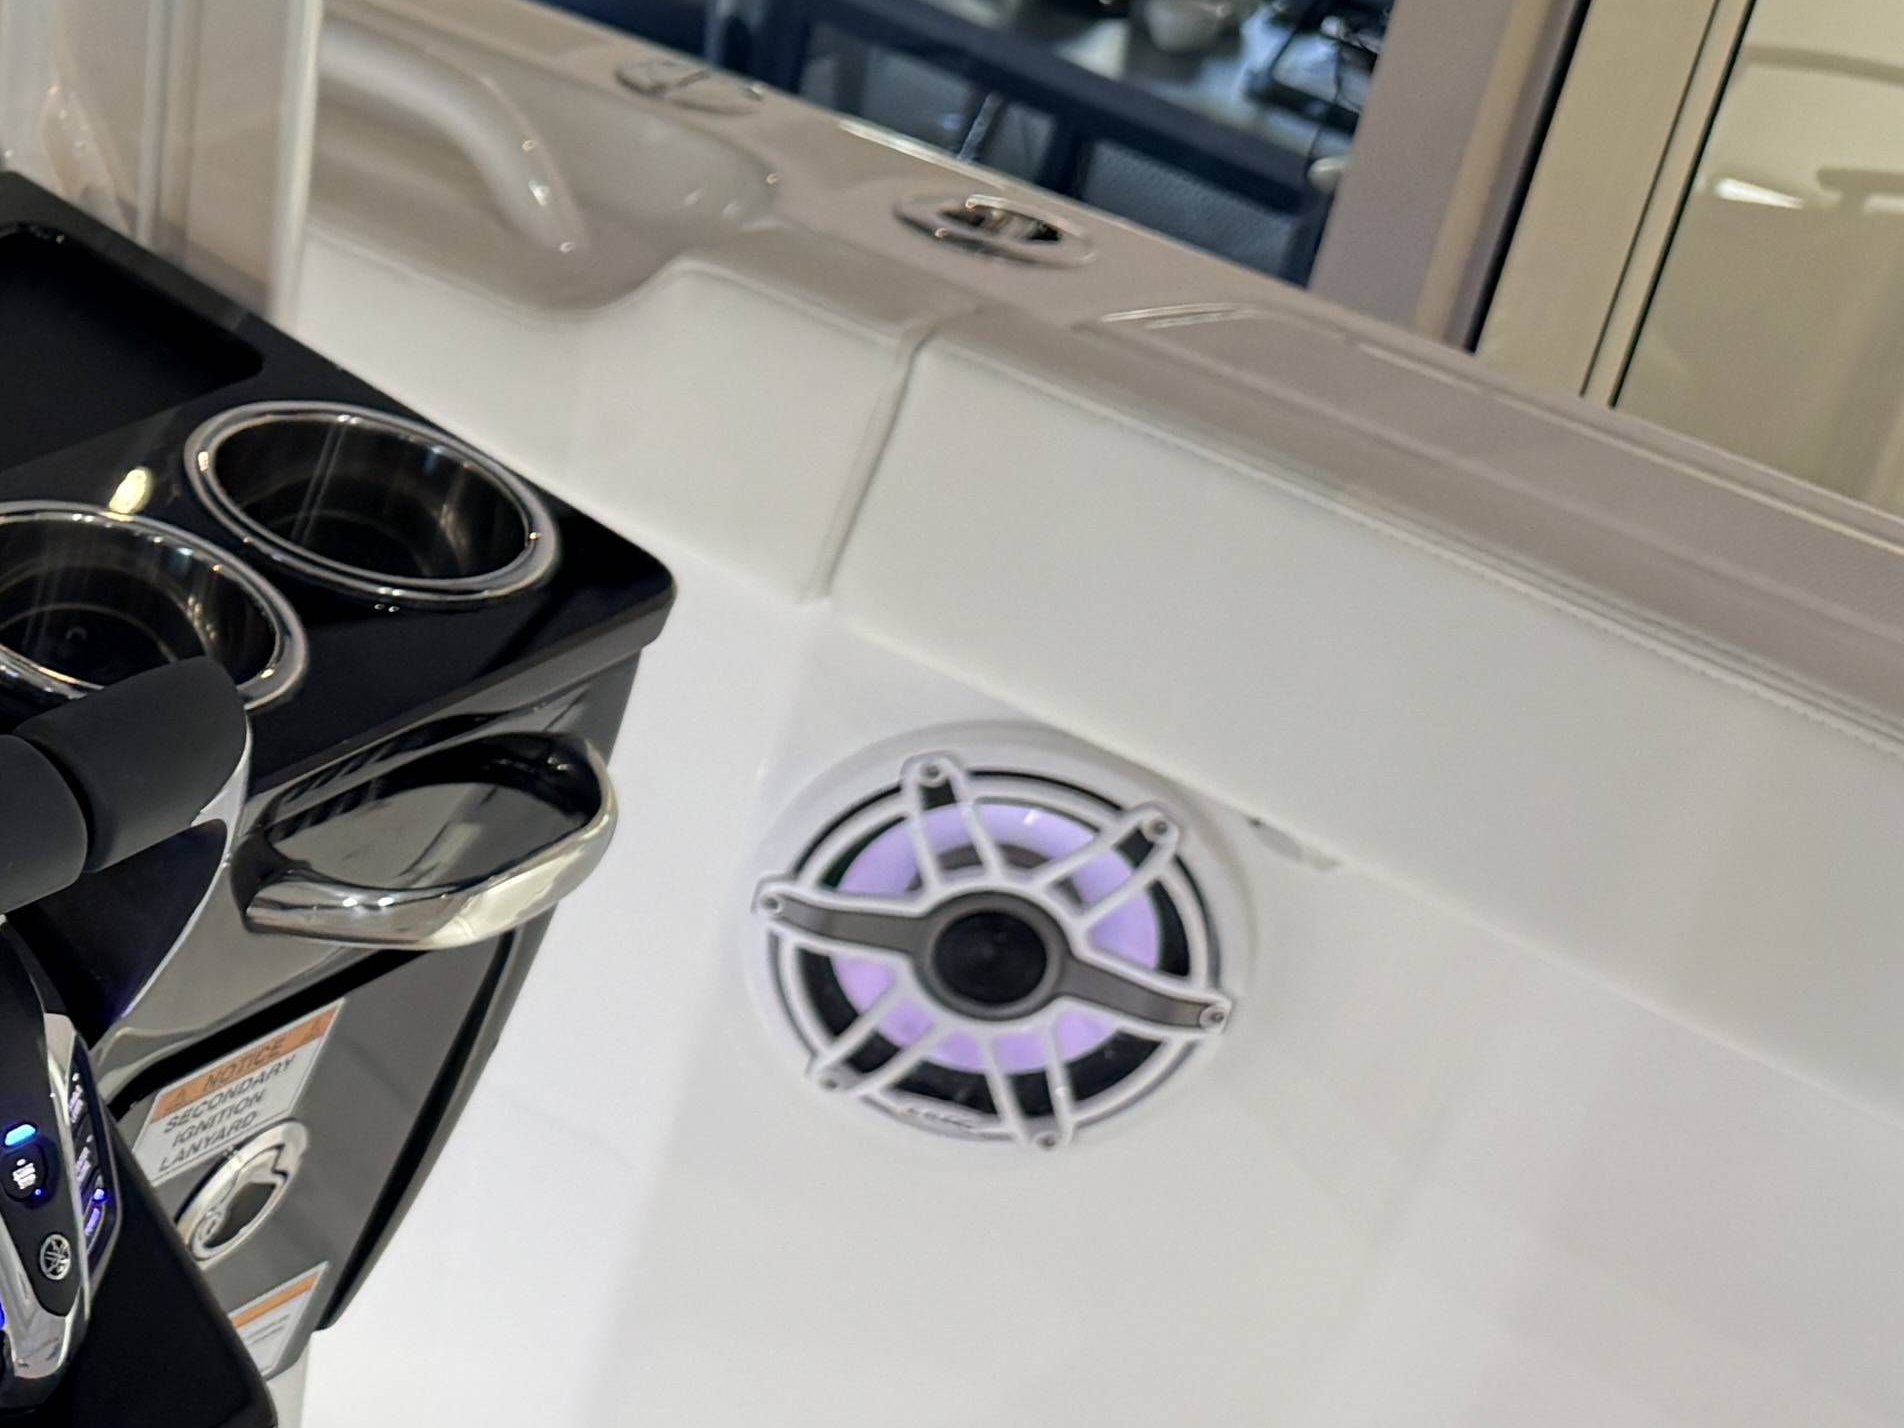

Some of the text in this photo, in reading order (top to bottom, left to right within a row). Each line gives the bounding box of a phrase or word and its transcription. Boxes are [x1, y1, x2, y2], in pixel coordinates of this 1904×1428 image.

[164, 1054, 296, 1134] SECONDARY
[203, 1038, 286, 1092] NOTICE
[158, 1111, 258, 1172] LANYARD
[172, 1089, 266, 1148] IGNITION
